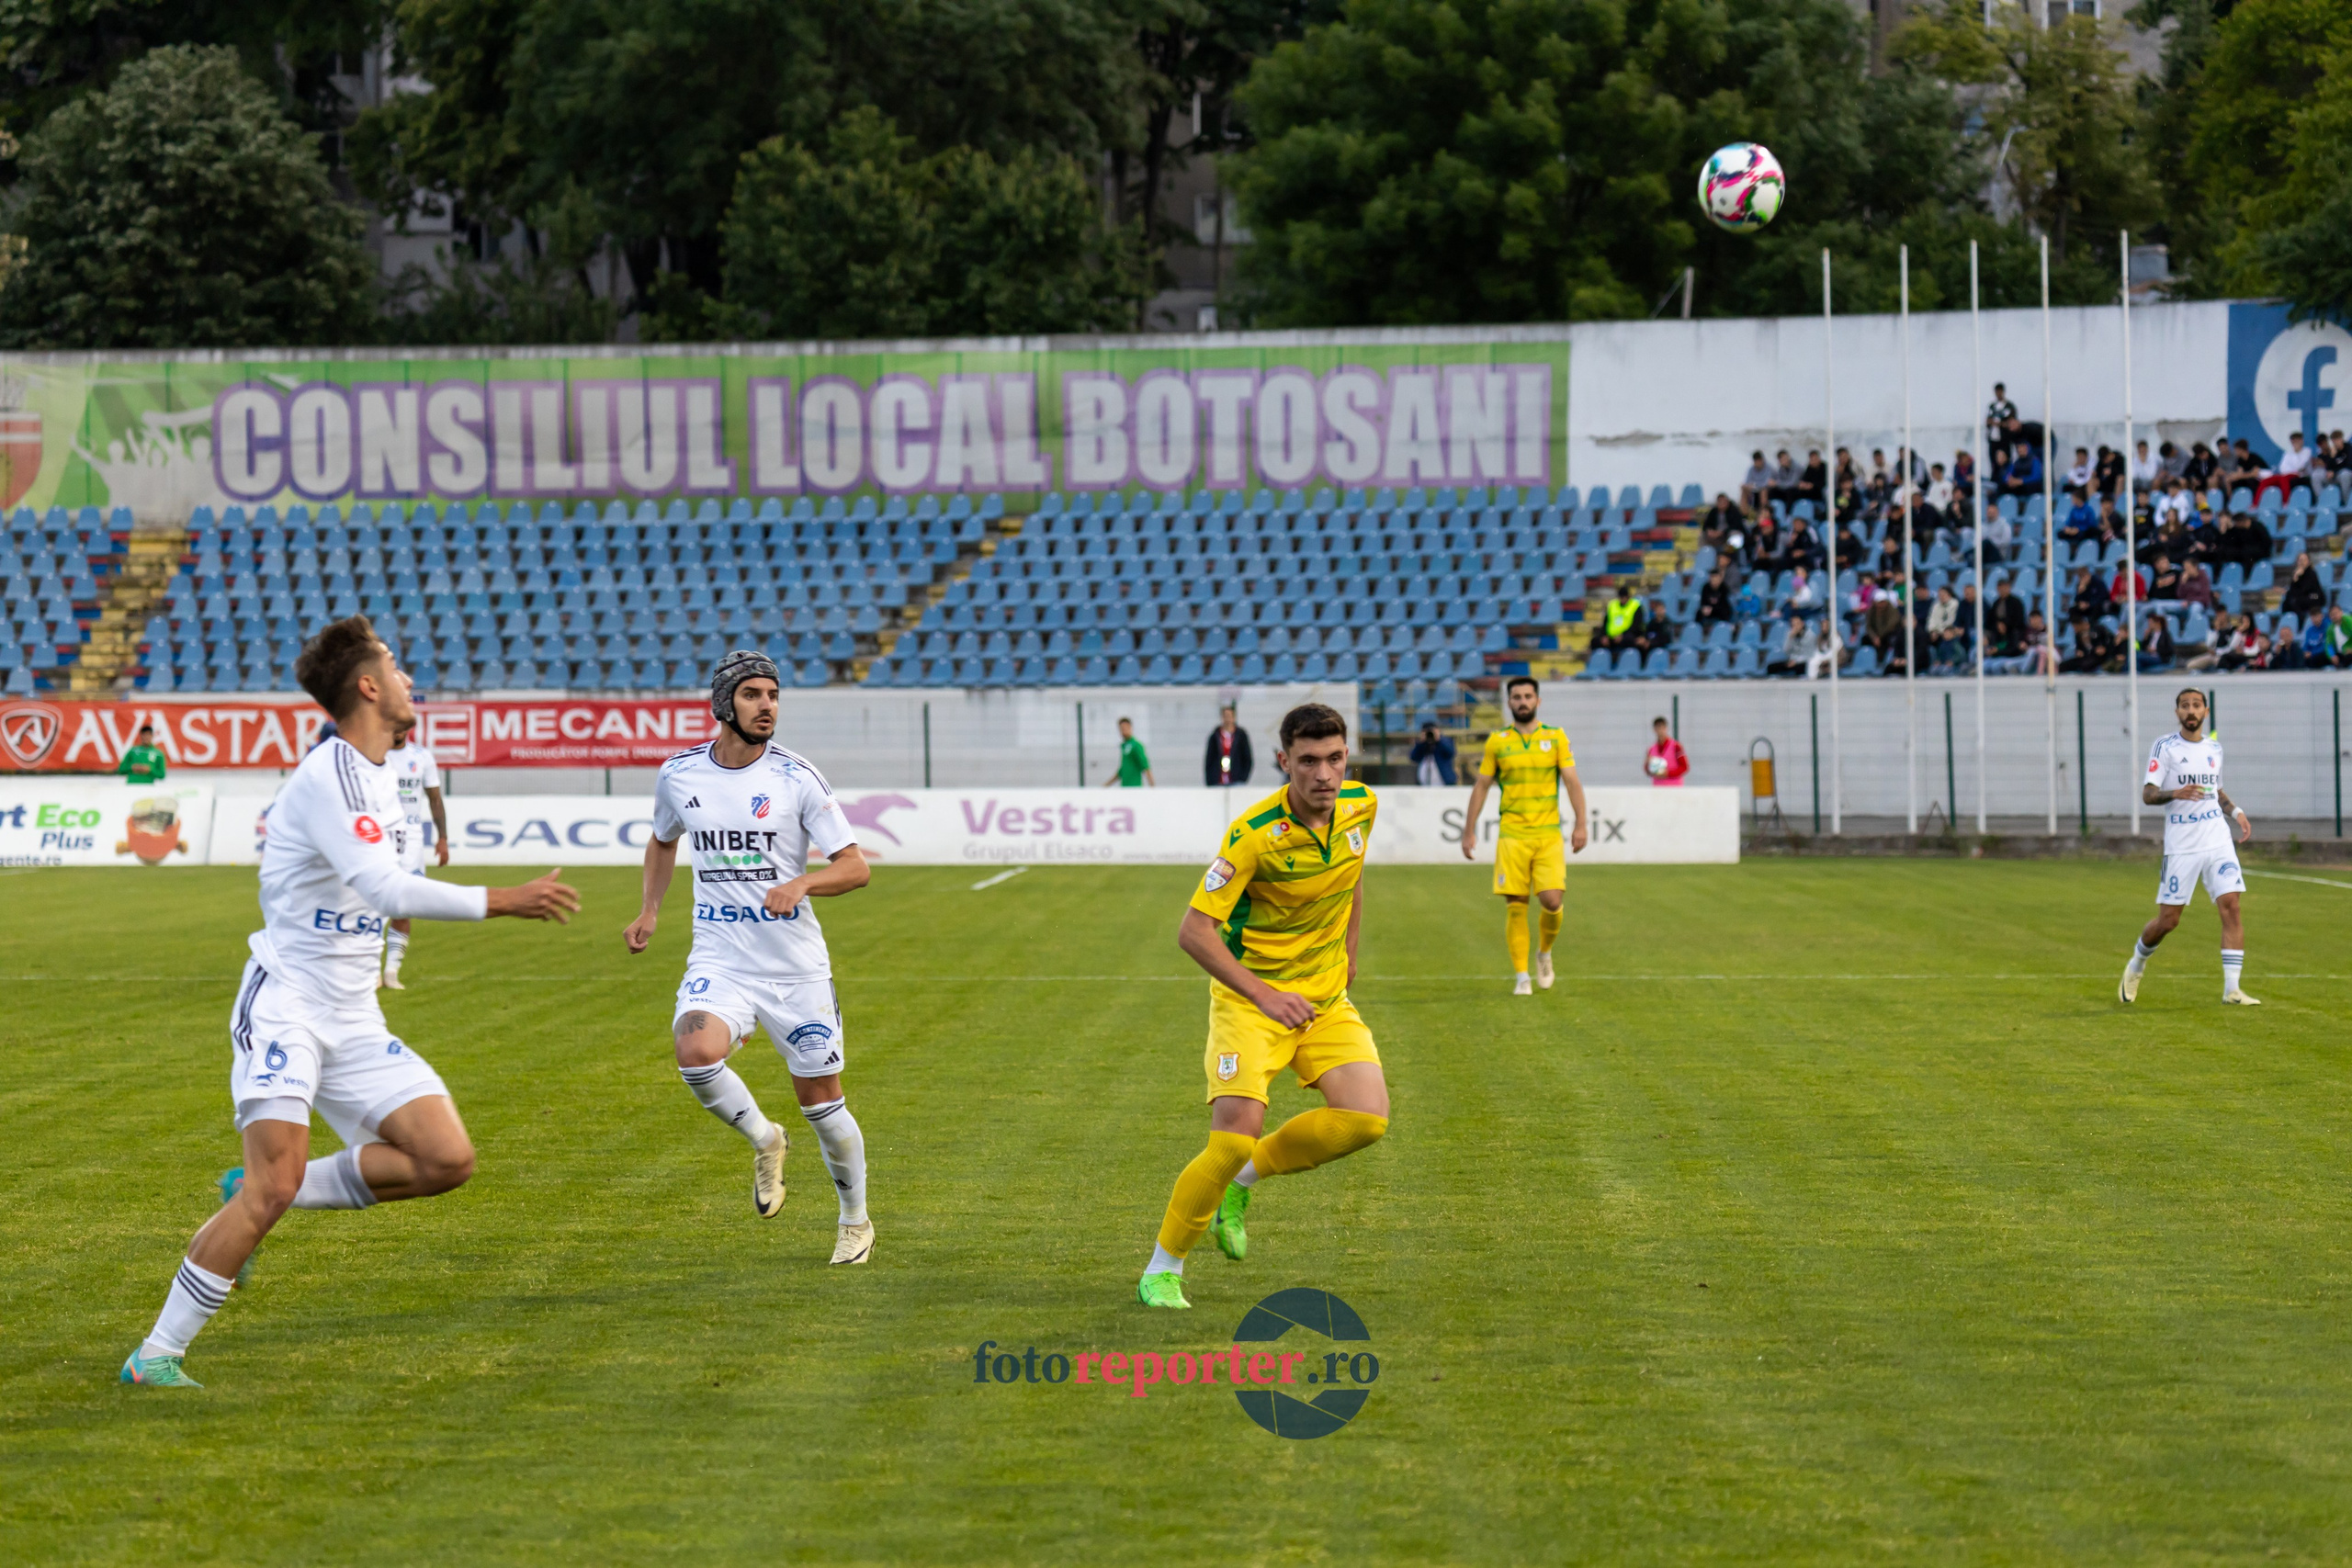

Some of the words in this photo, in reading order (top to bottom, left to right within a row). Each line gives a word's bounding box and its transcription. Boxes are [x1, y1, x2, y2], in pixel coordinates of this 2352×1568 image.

[213, 378, 738, 502] CONSILIUL
[748, 373, 1052, 496] LOCAL
[1063, 364, 1551, 490] BOTOSANI
[36, 804, 101, 828] Eco
[961, 799, 1136, 835] Vestra
[40, 831, 94, 850] Plus
[691, 830, 778, 852] UNIBET
[963, 842, 1035, 864] Grupul
[1044, 841, 1114, 860] Elsaco
[2169, 875, 2179, 894] 8
[265, 1040, 288, 1071] 6
